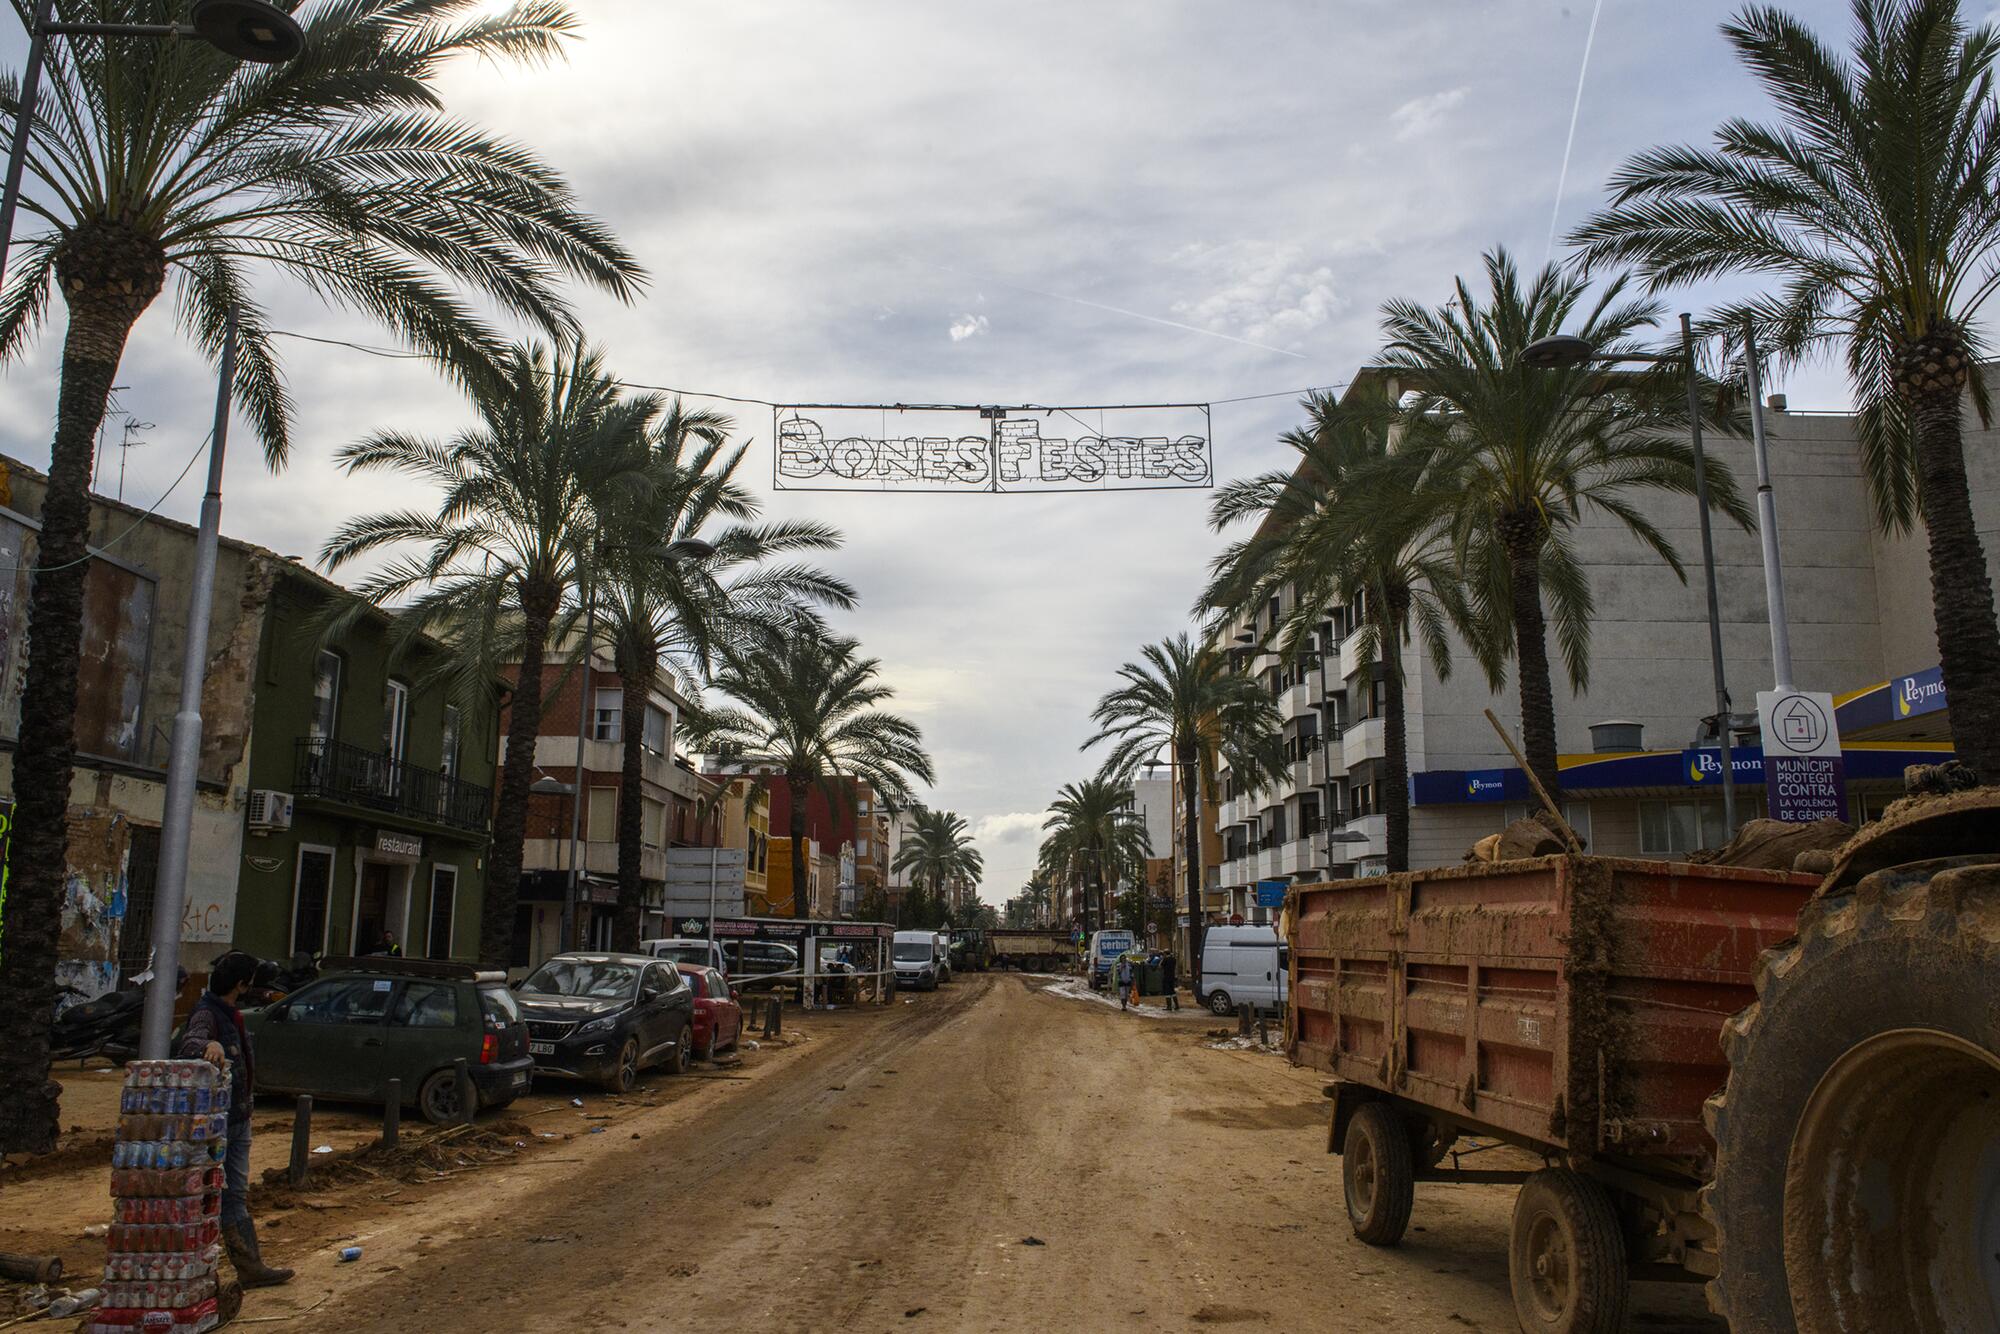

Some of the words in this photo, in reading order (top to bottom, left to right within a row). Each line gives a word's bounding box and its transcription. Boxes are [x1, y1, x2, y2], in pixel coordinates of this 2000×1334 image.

[1903, 677, 1947, 704] Peymo
[1776, 760, 1834, 772] MUNICIPI
[1777, 772, 1834, 784] PROTEGIT
[1471, 779, 1503, 791] Peymon
[1778, 784, 1837, 797] CONTRA
[1780, 799, 1791, 807] LA
[1793, 797, 1838, 808] VIOLÈNCIA
[1781, 810, 1796, 820] DE
[378, 838, 421, 857] restaurant
[1100, 940, 1130, 951] serbis
